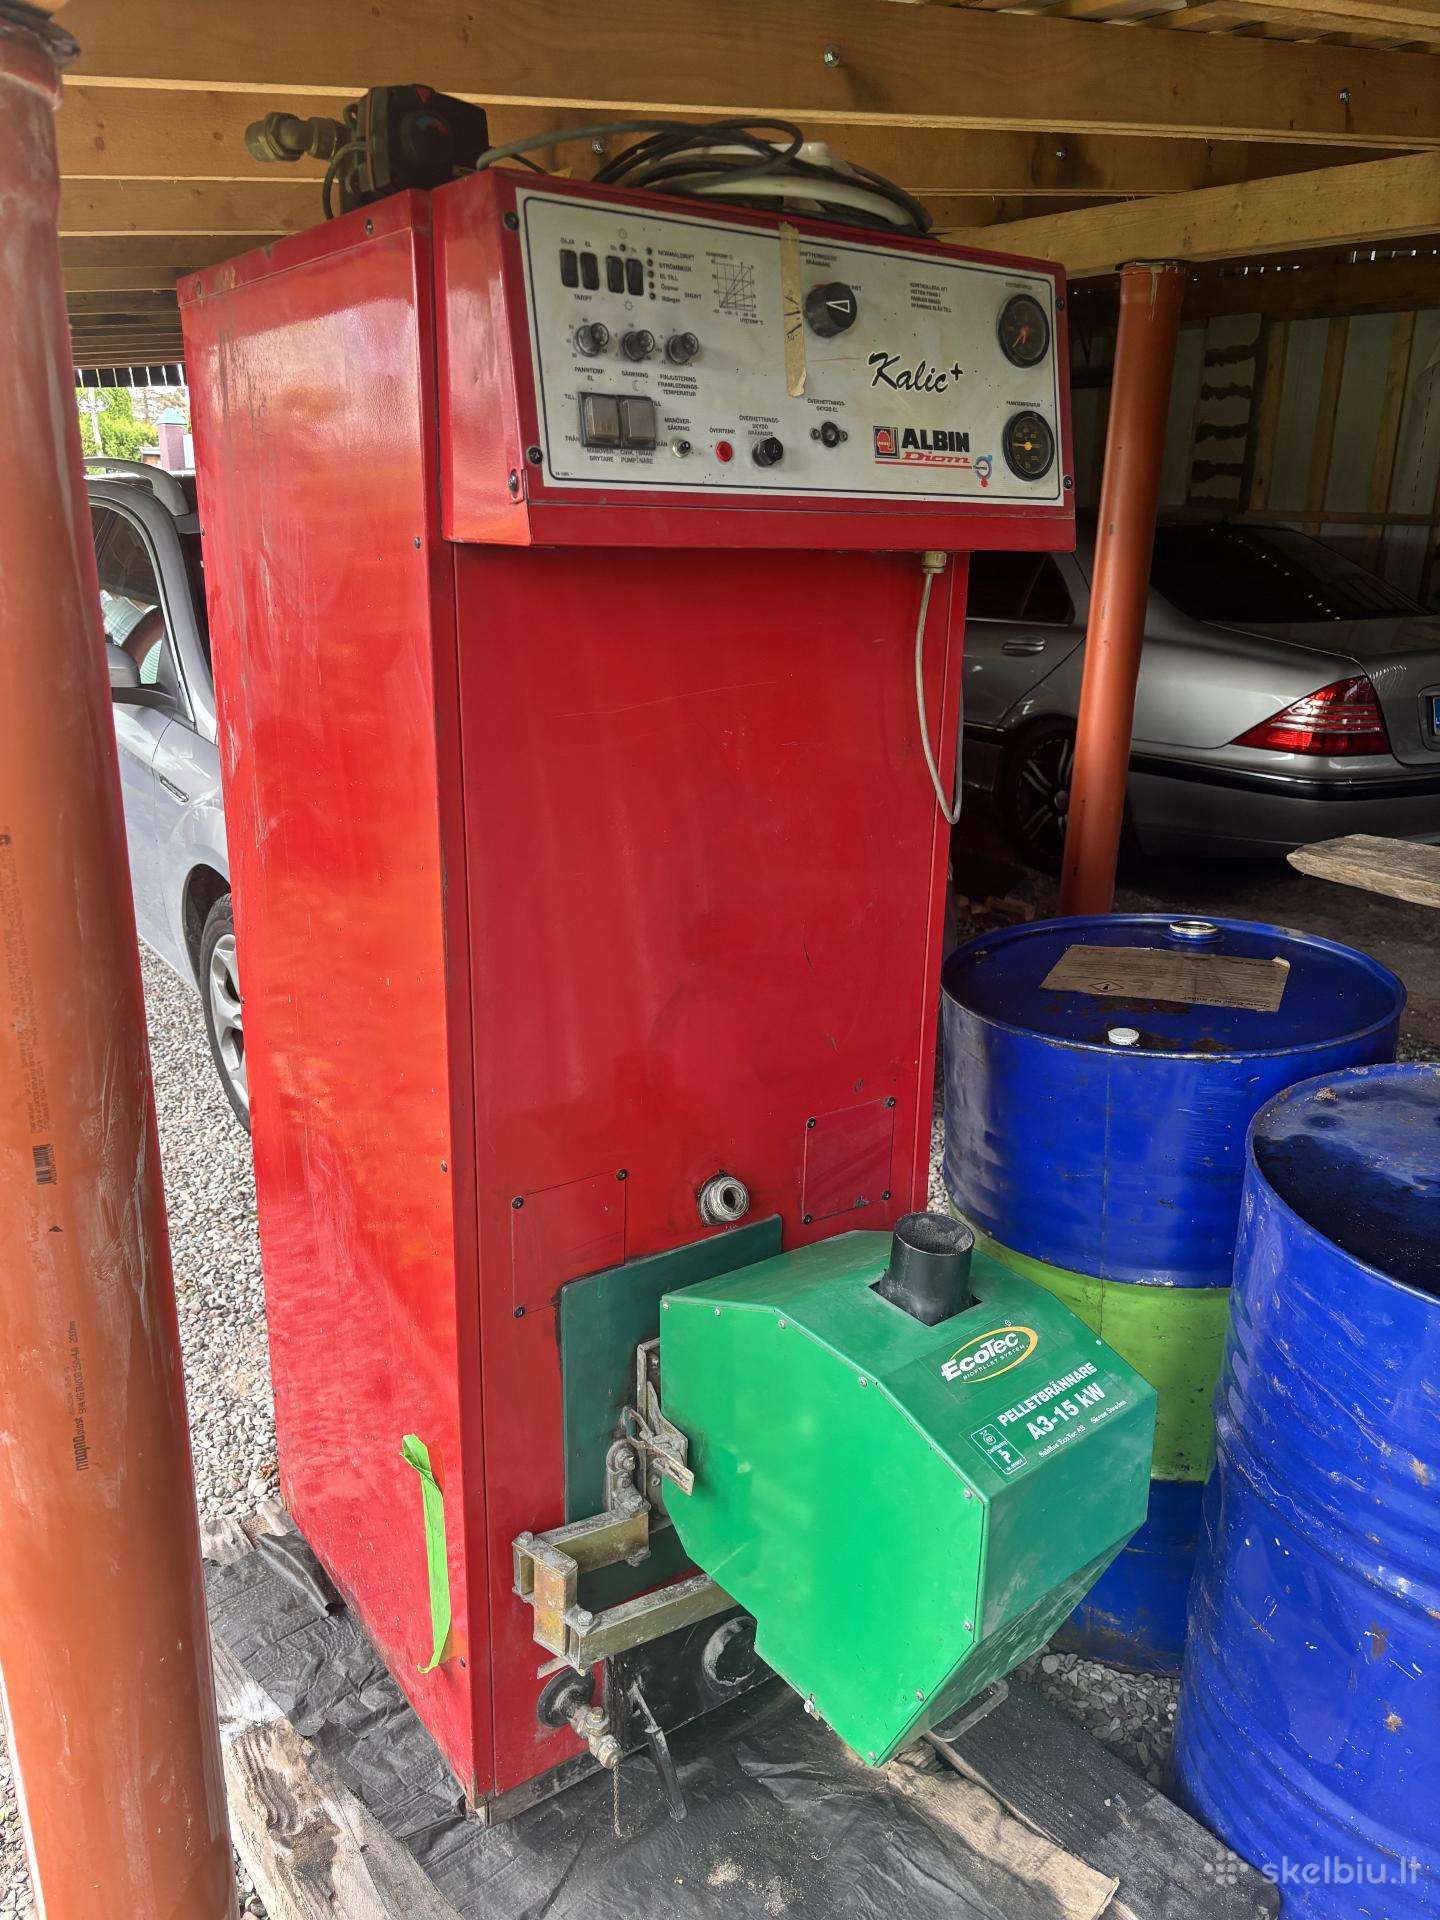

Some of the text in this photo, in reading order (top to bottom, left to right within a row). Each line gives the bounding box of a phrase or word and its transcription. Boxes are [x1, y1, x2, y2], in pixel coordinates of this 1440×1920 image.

[901, 427, 970, 453] ALBIN
[941, 1332, 1018, 1382] EcoTec
[997, 1362, 1098, 1427] PELLETBRÄNNARE
[1026, 1382, 1107, 1441] A3-15 kW
[1076, 1424, 1086, 1434] AB
